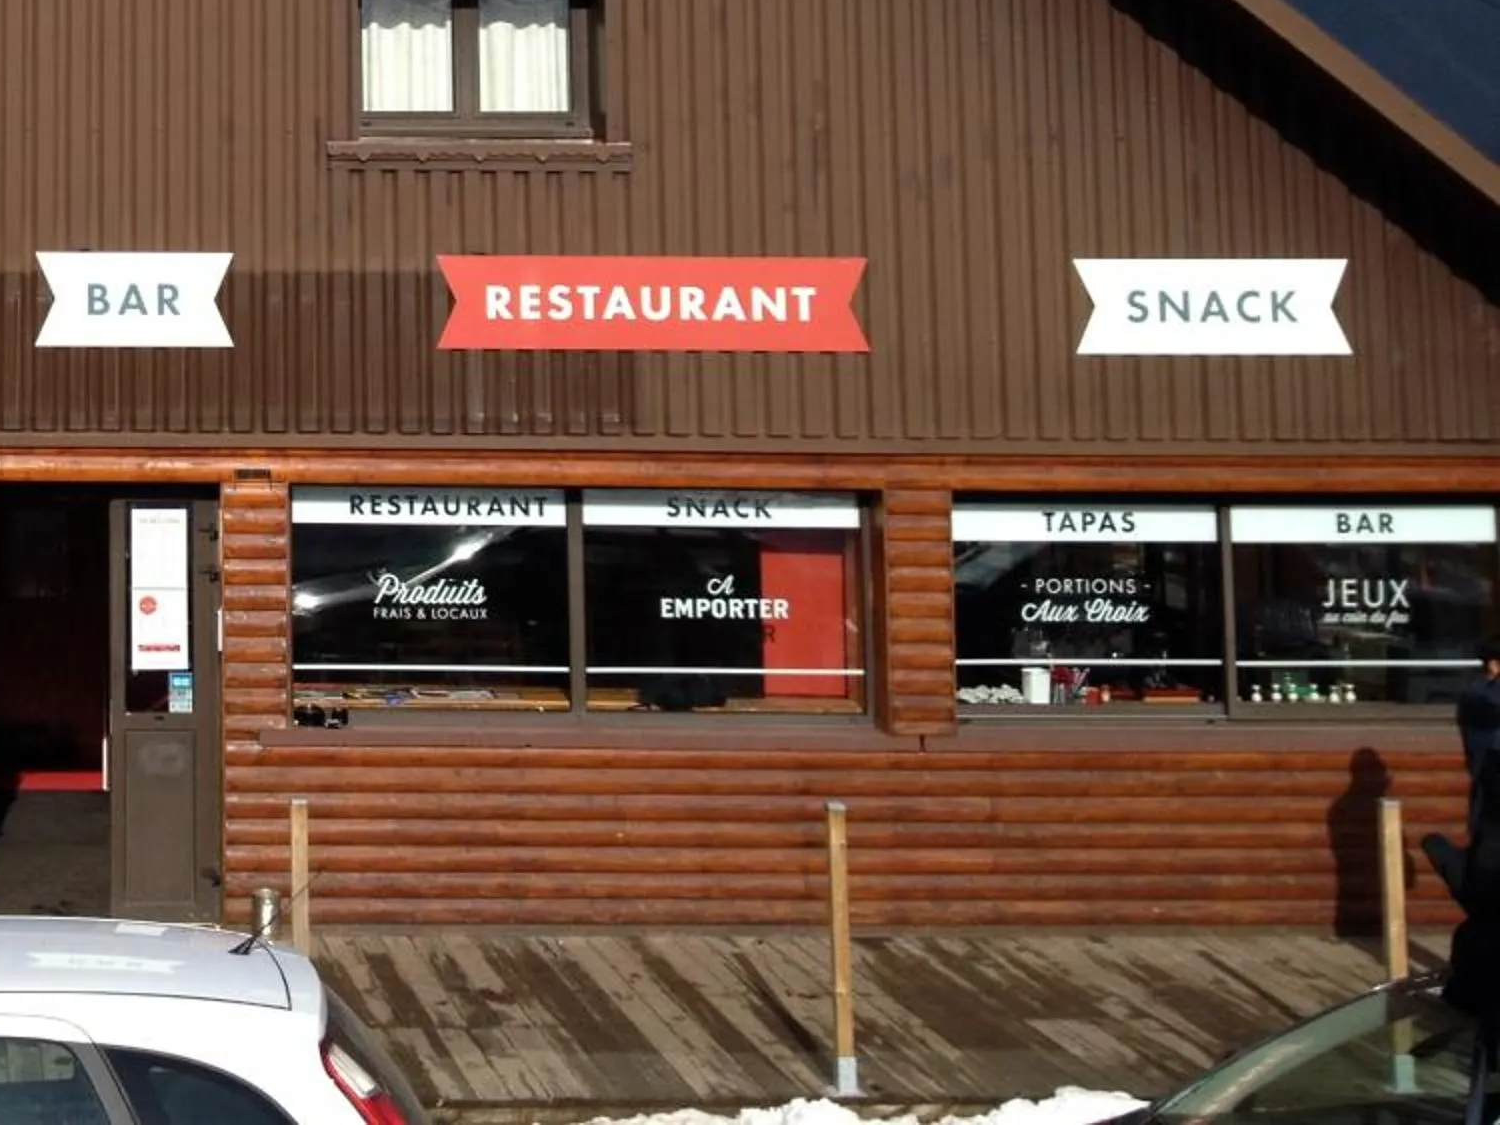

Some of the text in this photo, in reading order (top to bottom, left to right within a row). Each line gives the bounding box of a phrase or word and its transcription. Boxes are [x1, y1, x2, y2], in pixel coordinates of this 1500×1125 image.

[87, 283, 181, 316] BAR
[485, 284, 817, 322] RESTAURANT
[1127, 290, 1299, 324] SNACK
[350, 494, 548, 517] RESTAURANT
[666, 496, 772, 519] SNACK
[1043, 512, 1136, 532] TAPAS
[1336, 513, 1395, 534] BAR
[373, 573, 487, 605] Produits
[1035, 578, 1137, 594] PORTIONS
[1322, 578, 1410, 608] JEUX
[373, 607, 488, 620] FRAIS & LOCAUX
[659, 597, 789, 619] EMPORTER
[1021, 597, 1150, 623] Aux Choix
